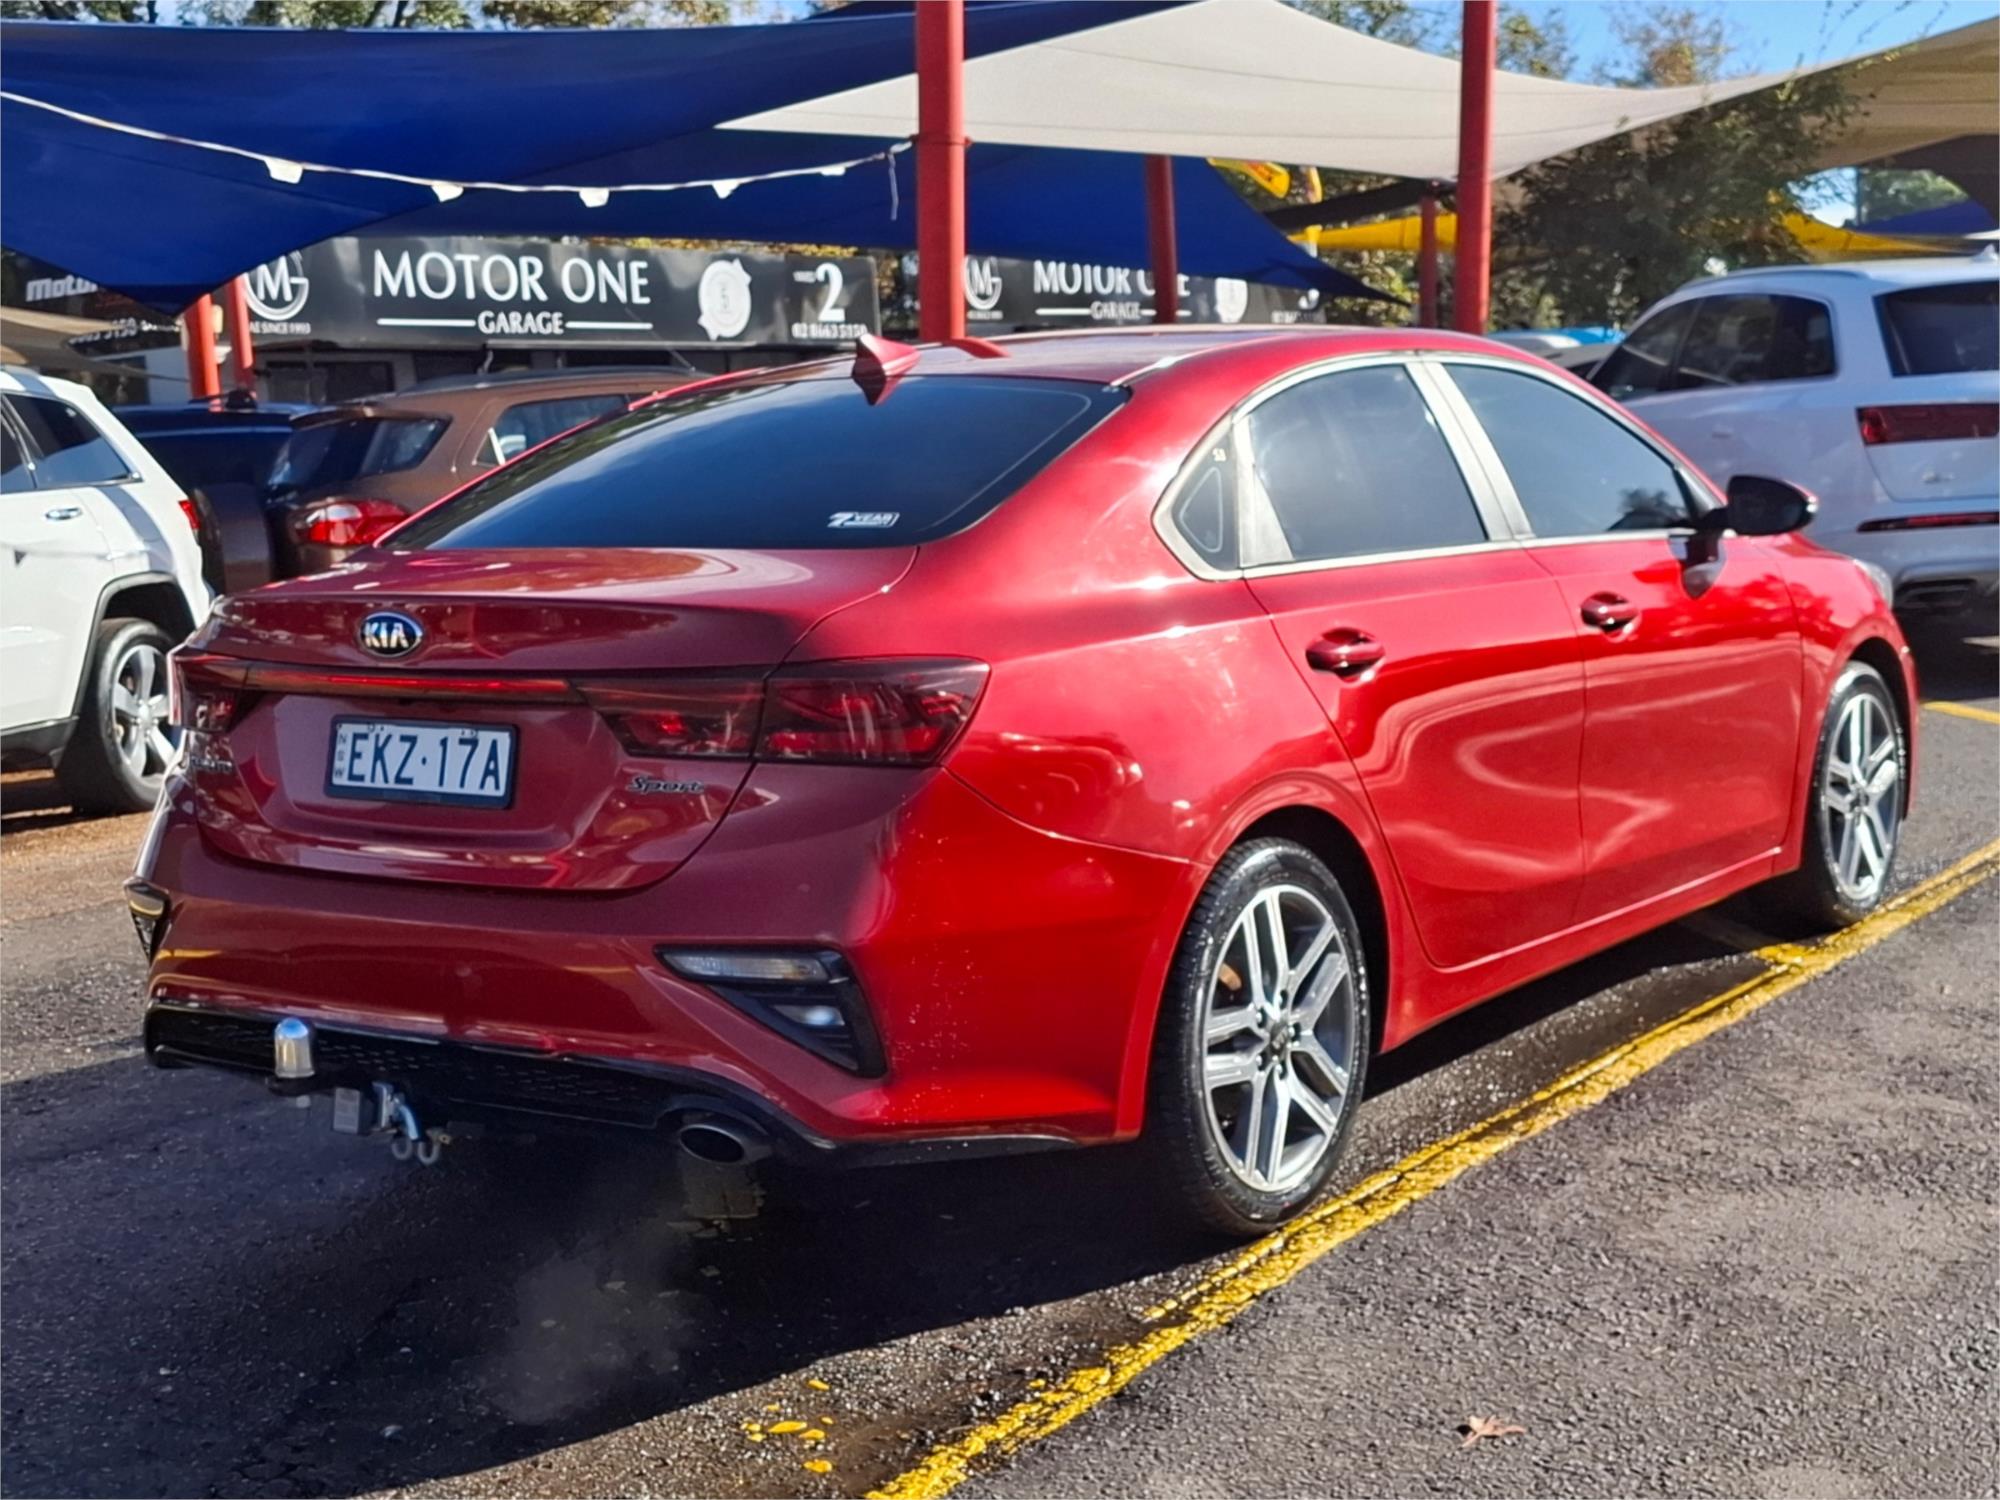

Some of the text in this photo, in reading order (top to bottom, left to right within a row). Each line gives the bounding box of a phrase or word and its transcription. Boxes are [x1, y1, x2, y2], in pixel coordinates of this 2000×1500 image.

[373, 249, 651, 304] MOTOR ONE
[1136, 269, 1191, 296] OE
[815, 262, 845, 322] 2
[478, 310, 564, 335] GARAGE
[1090, 301, 1141, 320] GARAGE
[362, 622, 410, 649] KIA
[630, 777, 704, 795] Sport
